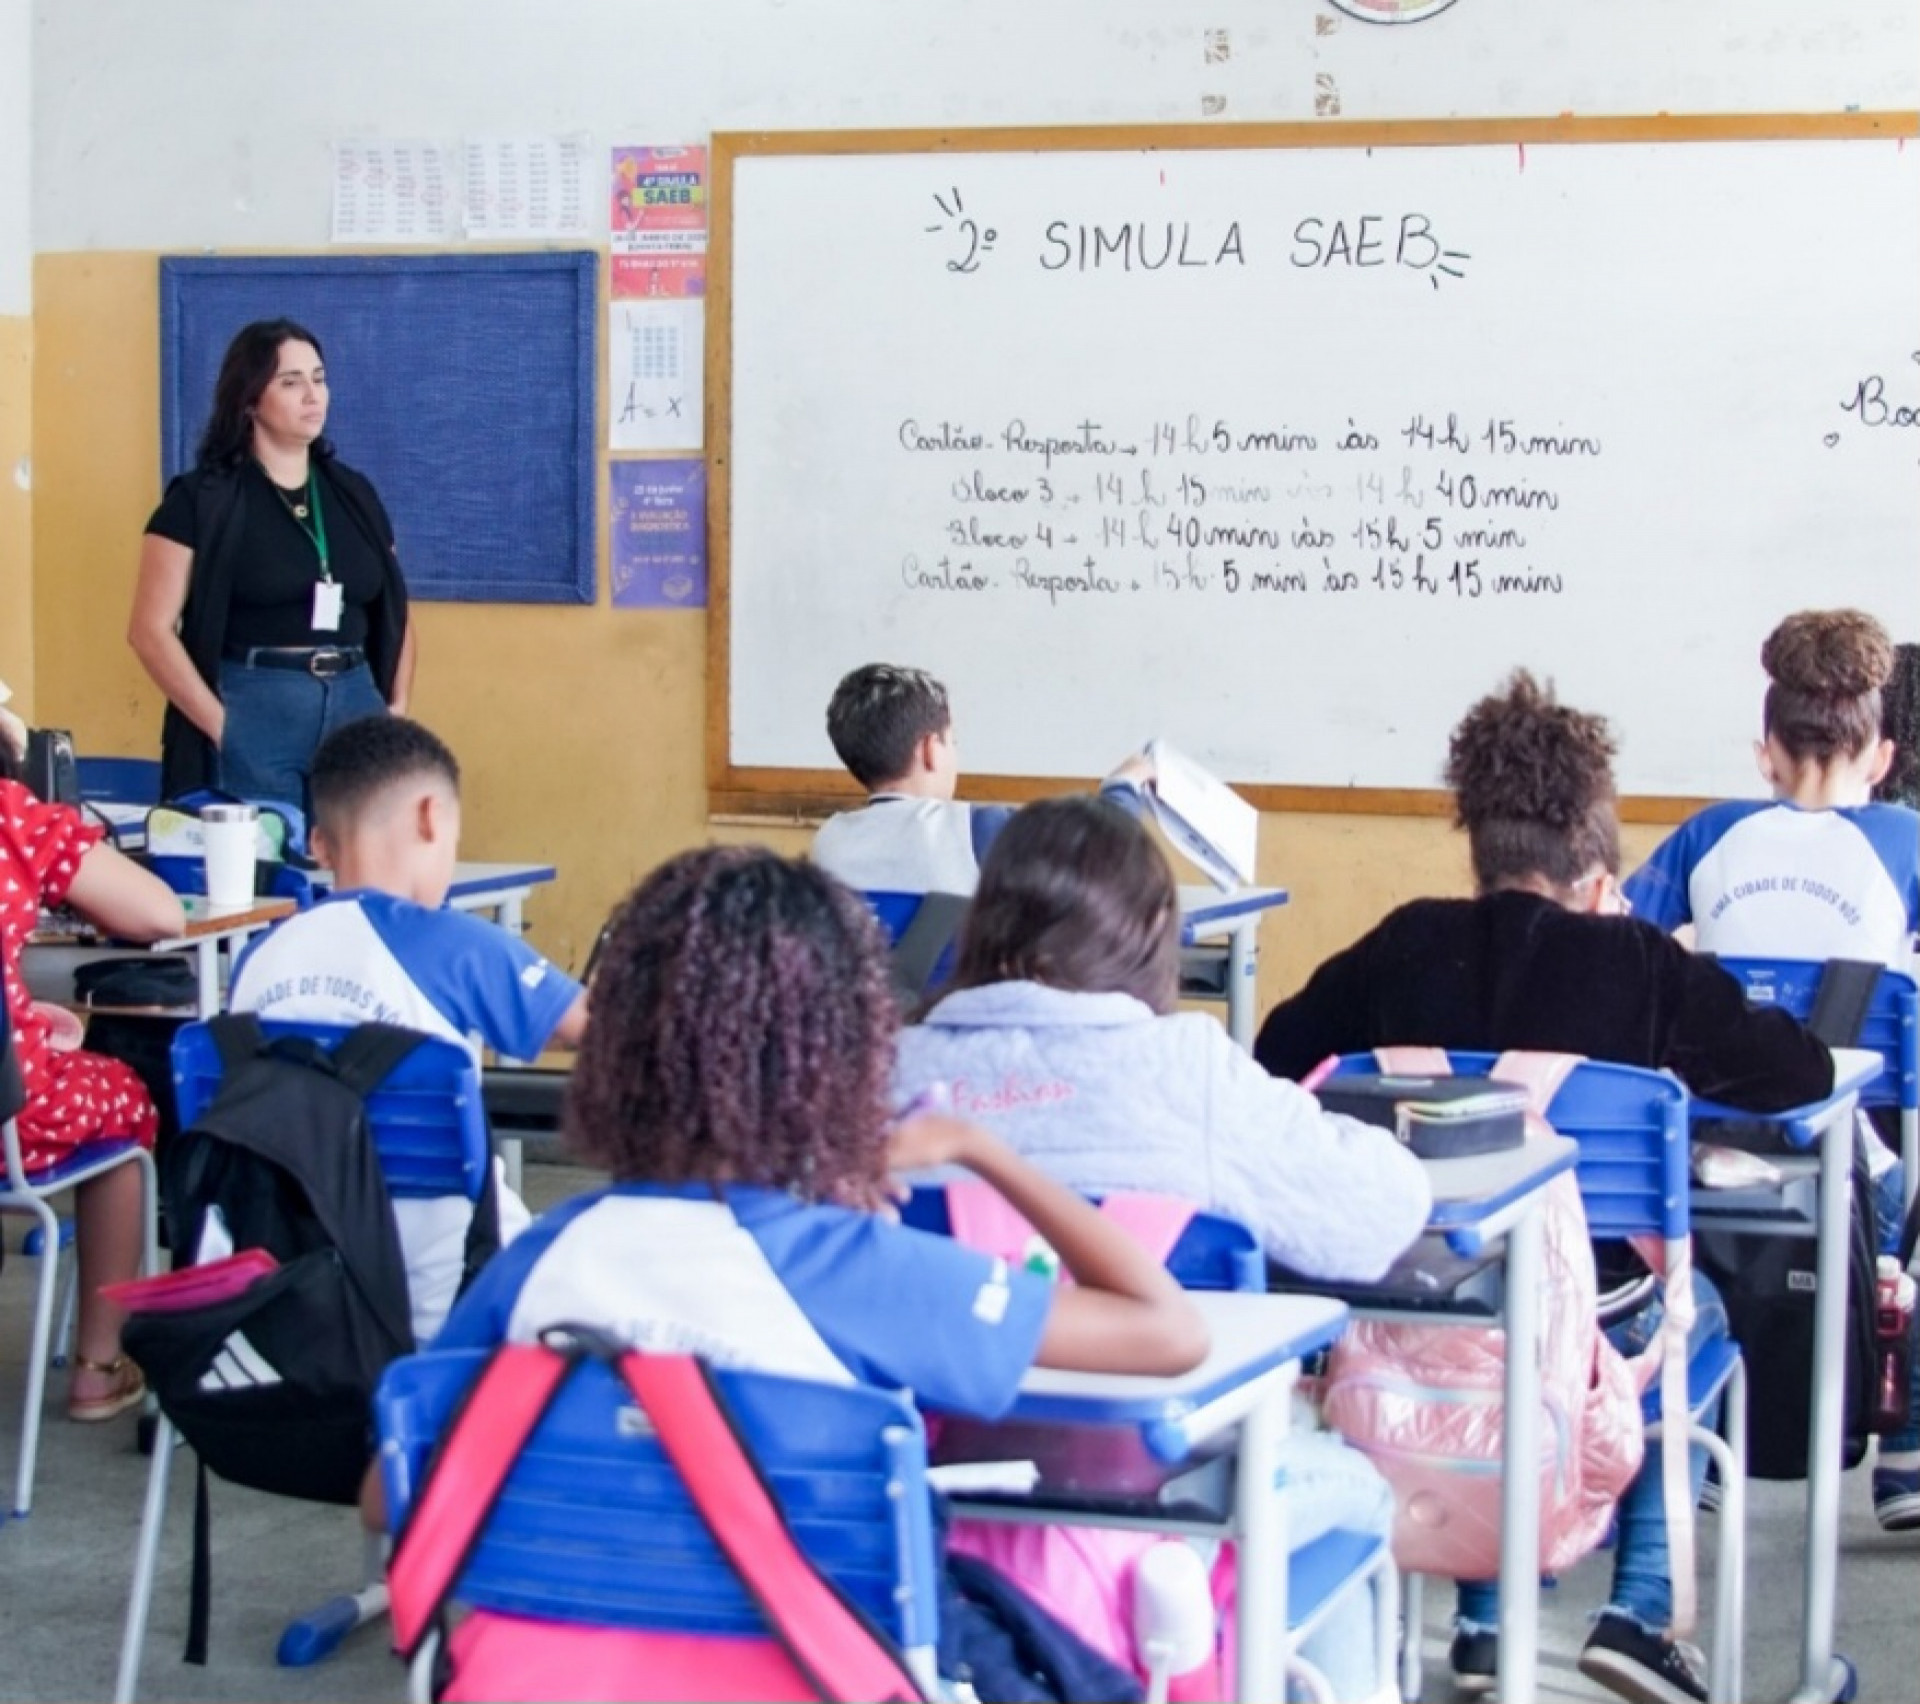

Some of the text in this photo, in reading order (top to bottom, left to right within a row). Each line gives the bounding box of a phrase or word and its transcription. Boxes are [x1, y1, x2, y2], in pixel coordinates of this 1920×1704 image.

[644, 189, 690, 205] SAEB
[1040, 220, 1245, 271] SIMULA
[1290, 214, 1439, 269] SAEB
[1036, 476, 1054, 502] 3
[1035, 520, 1054, 549] 4
[1454, 518, 1527, 549] min
[1733, 876, 1778, 900] CIDADE
[1781, 876, 1799, 892] DE
[1801, 878, 1840, 905] TODOS
[300, 975, 321, 996] DE
[323, 975, 374, 1010] TODOS
